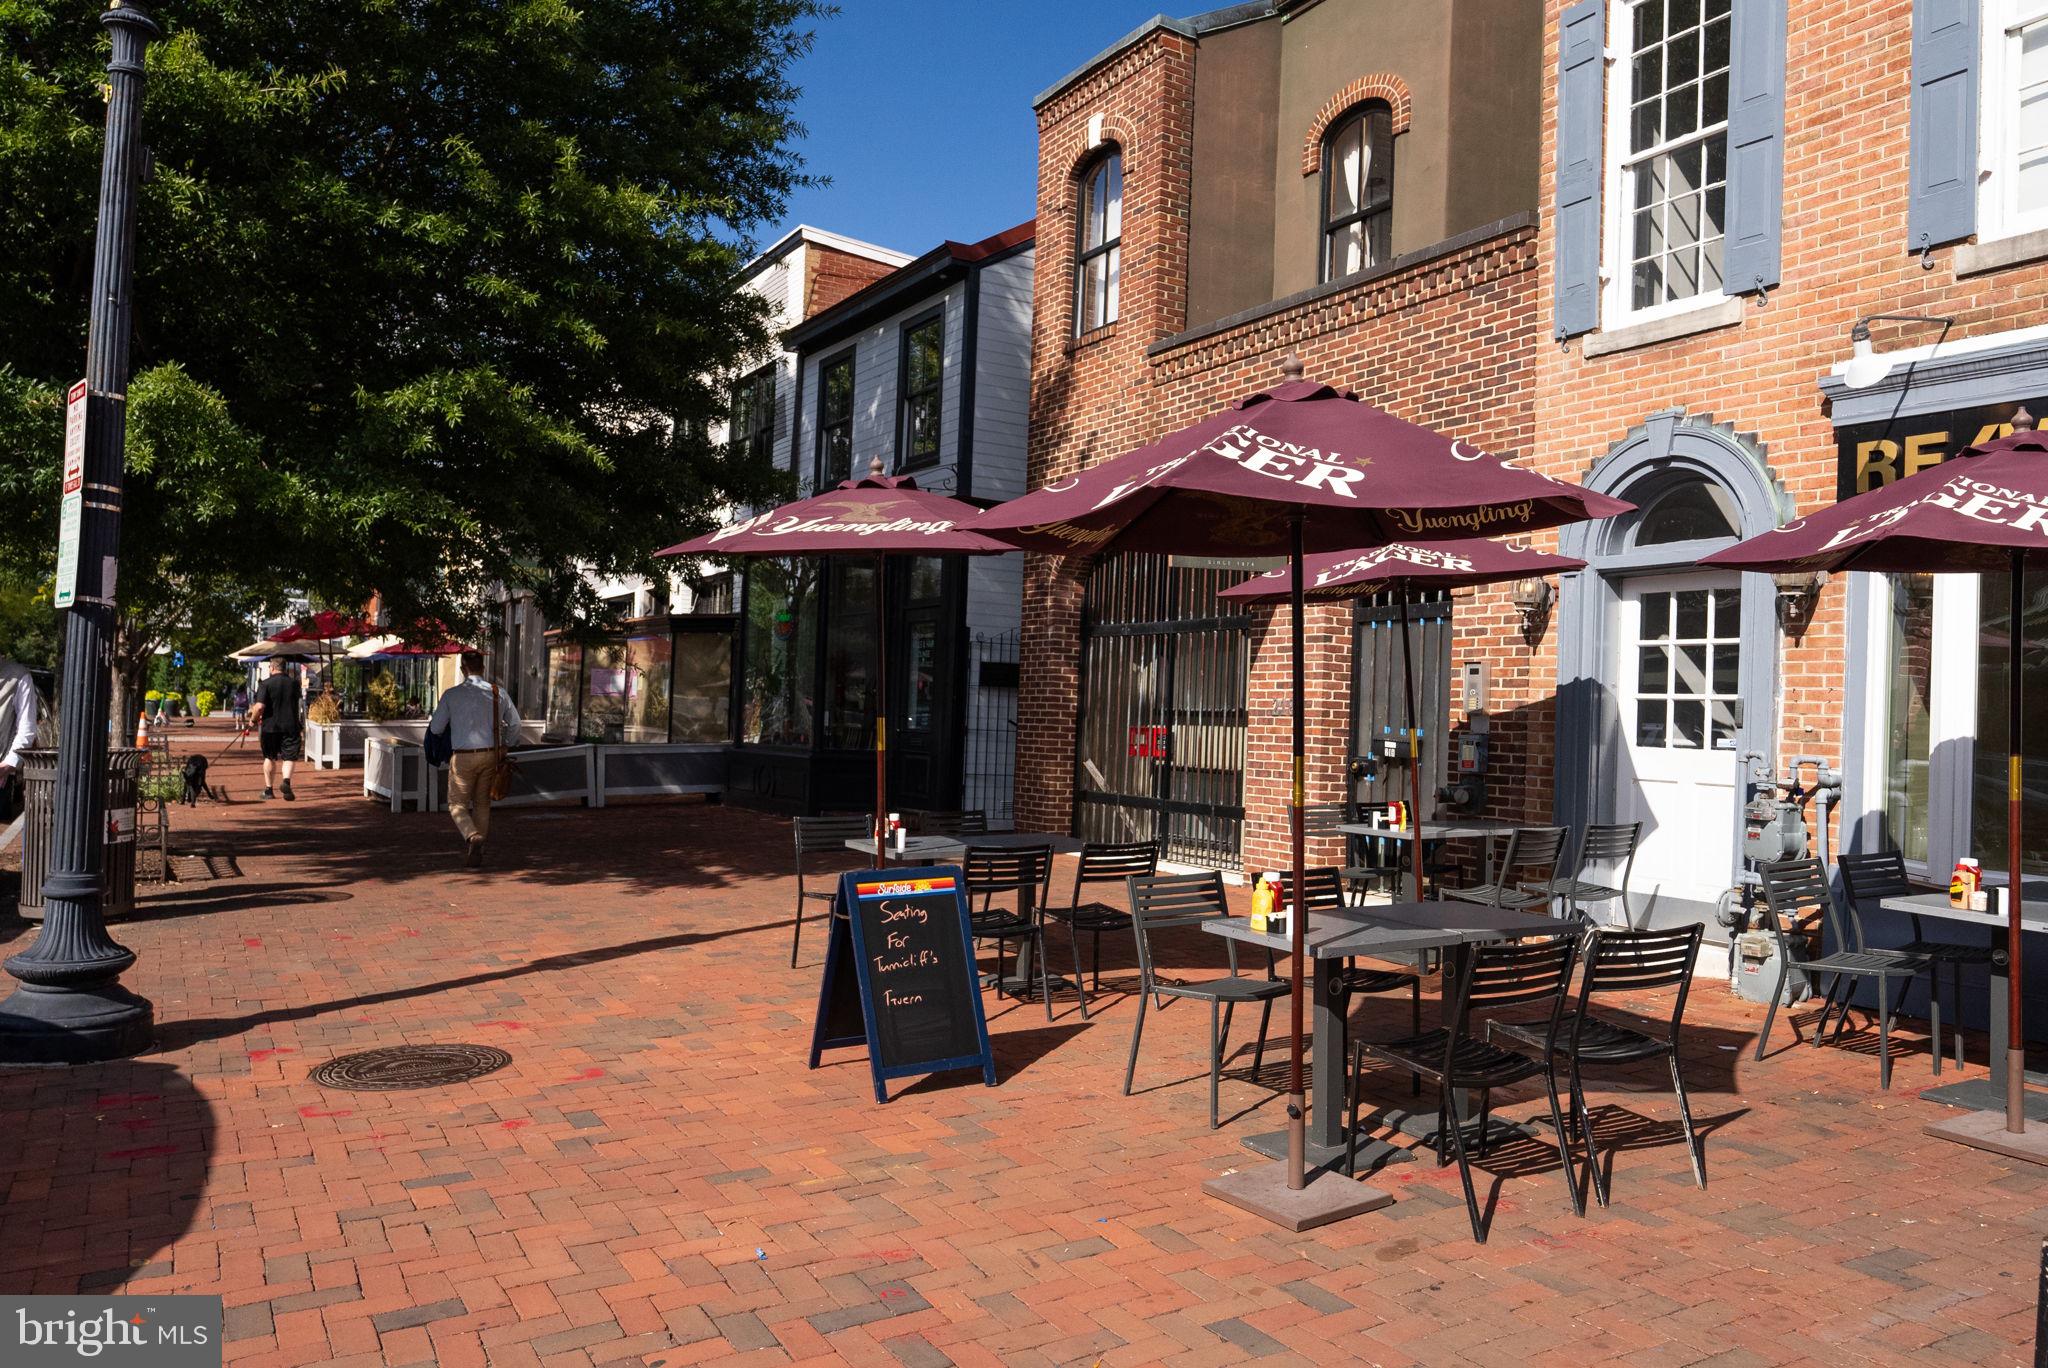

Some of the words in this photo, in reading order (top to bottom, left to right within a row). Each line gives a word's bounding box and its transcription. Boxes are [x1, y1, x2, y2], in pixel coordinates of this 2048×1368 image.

[752, 516, 956, 536] Yuengling
[1385, 500, 1533, 533] Yuengling
[1314, 547, 1477, 587] LAGER
[878, 883, 912, 896] Surfside
[880, 900, 928, 924] Seating
[887, 931, 910, 949] For
